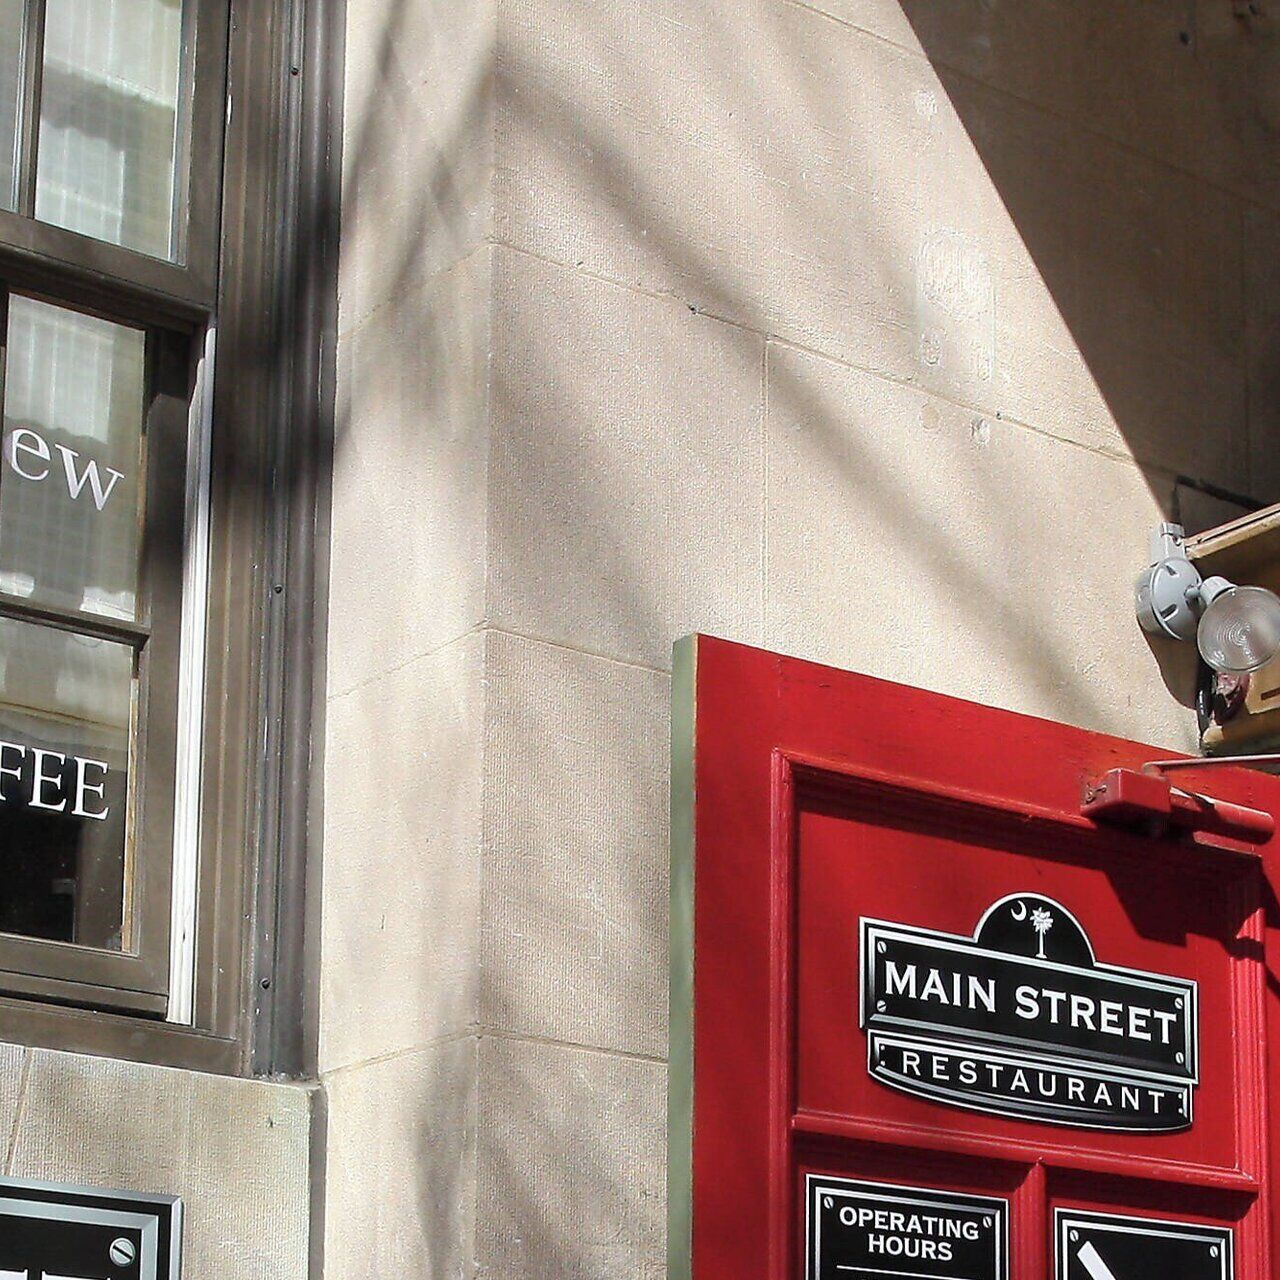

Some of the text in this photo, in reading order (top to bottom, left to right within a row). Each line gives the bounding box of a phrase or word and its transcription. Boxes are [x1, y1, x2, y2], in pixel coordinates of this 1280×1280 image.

[885, 960, 1177, 1044] MAIN STREET
[902, 1050, 1165, 1114] RESTAURANT
[839, 1206, 980, 1241] OPERATING
[868, 1233, 953, 1261] HOURS
